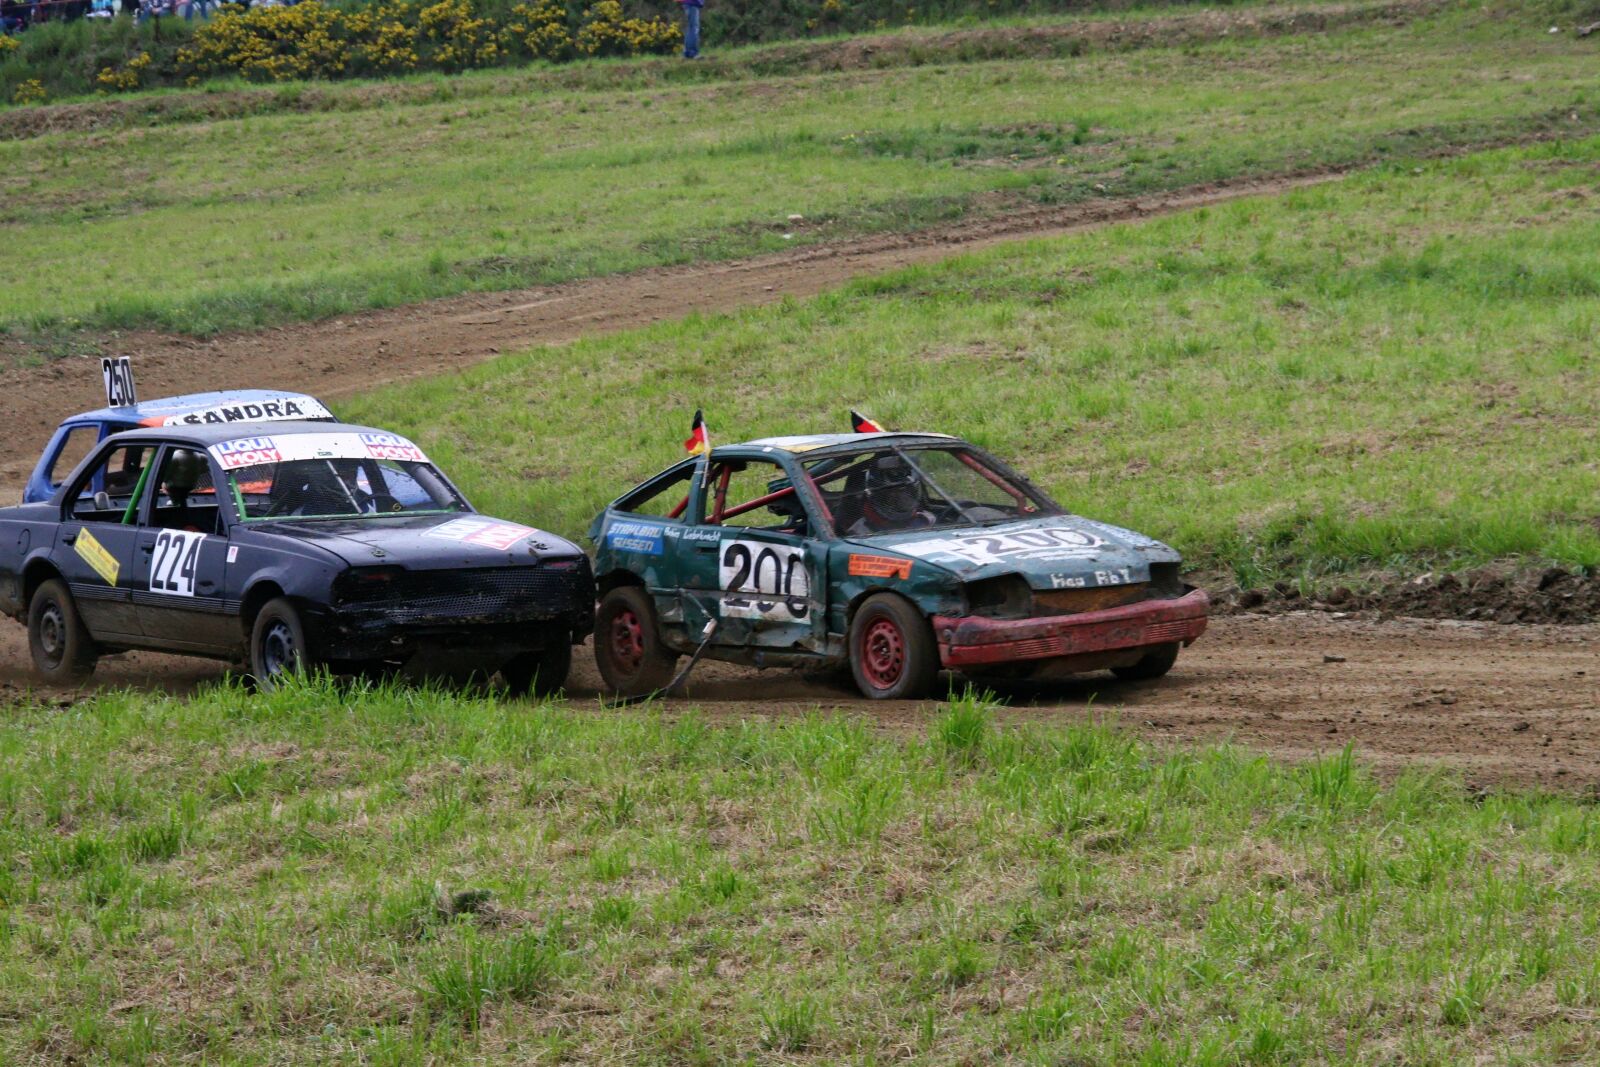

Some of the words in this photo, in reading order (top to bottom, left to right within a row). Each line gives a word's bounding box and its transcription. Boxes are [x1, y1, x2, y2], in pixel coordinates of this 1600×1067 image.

[103, 358, 136, 406] 250
[183, 400, 304, 425] SANDRA
[217, 436, 275, 455] LIQUI
[360, 433, 414, 449] LIQUI
[367, 446, 420, 460] MOLY
[222, 449, 282, 467] MOLY
[961, 527, 1097, 557] 200
[151, 532, 203, 593] 224
[723, 543, 810, 619] 200
